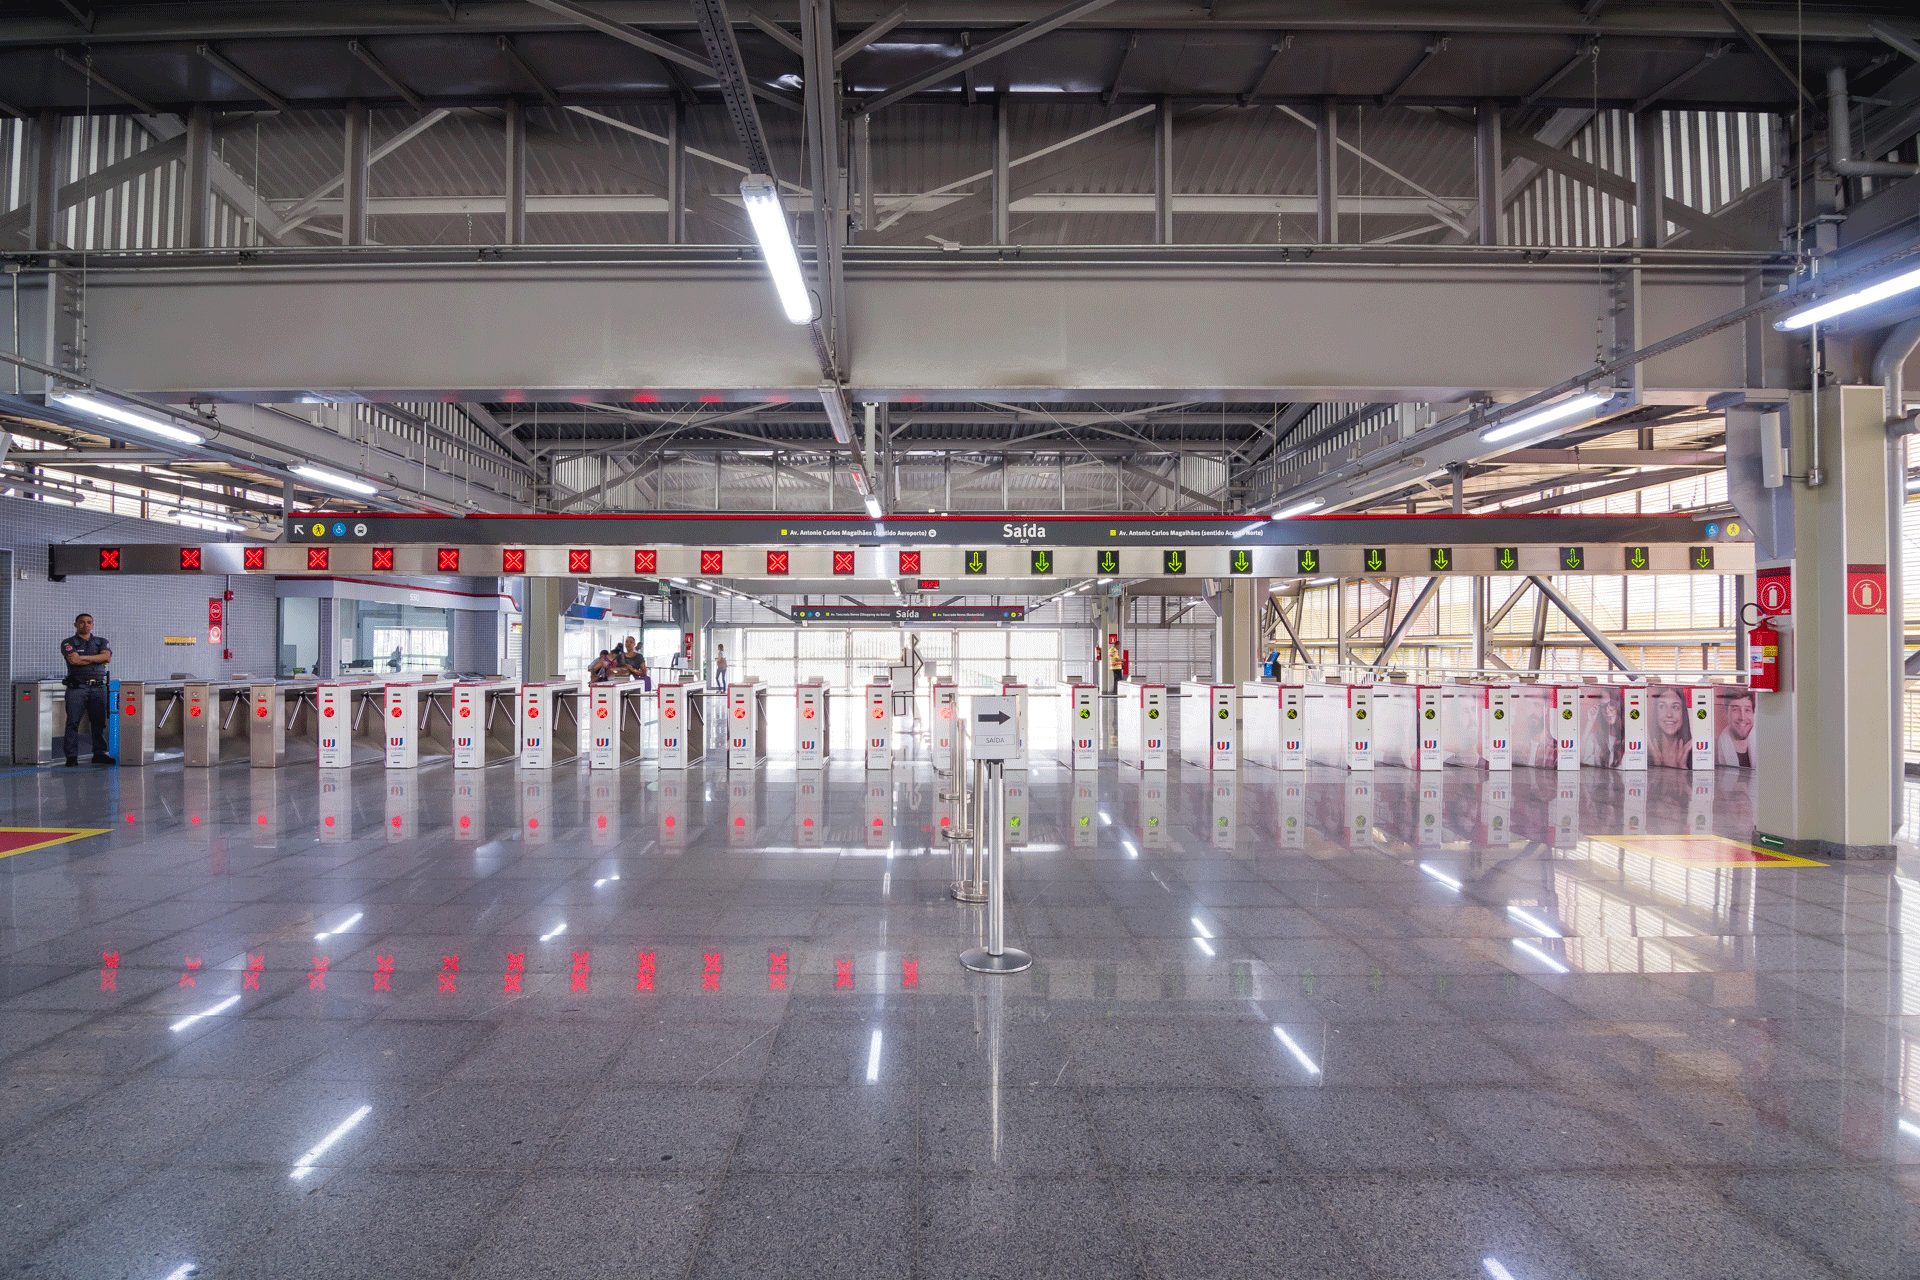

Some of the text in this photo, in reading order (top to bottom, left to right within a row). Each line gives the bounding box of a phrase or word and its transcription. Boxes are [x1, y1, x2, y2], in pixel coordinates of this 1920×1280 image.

[841, 529, 872, 538] Magalhães
[897, 529, 928, 538] Aeroporto)
[1003, 523, 1046, 538] Saída
[1170, 529, 1200, 538] Magalhães
[1201, 529, 1225, 537] (sentido
[896, 610, 919, 618] Saída
[323, 739, 335, 747] UJ
[391, 738, 403, 746] UJ
[459, 738, 471, 746] UJ
[528, 739, 540, 747] UJ
[597, 739, 609, 747] UJ
[665, 739, 677, 747] UJ
[734, 739, 746, 747] UJ
[802, 741, 815, 749] UJ
[872, 739, 884, 747] UJ
[940, 739, 949, 747] U
[1079, 740, 1091, 748] UJ
[1148, 740, 1160, 748] UJ
[1217, 742, 1229, 750] UJ
[1287, 742, 1299, 750] UJ
[1355, 742, 1367, 750] UJ
[1425, 740, 1436, 748] UJ
[1494, 740, 1505, 748] UJ
[1561, 740, 1573, 748] UJ
[1629, 742, 1641, 750] UJ
[1697, 742, 1708, 750] UJ
